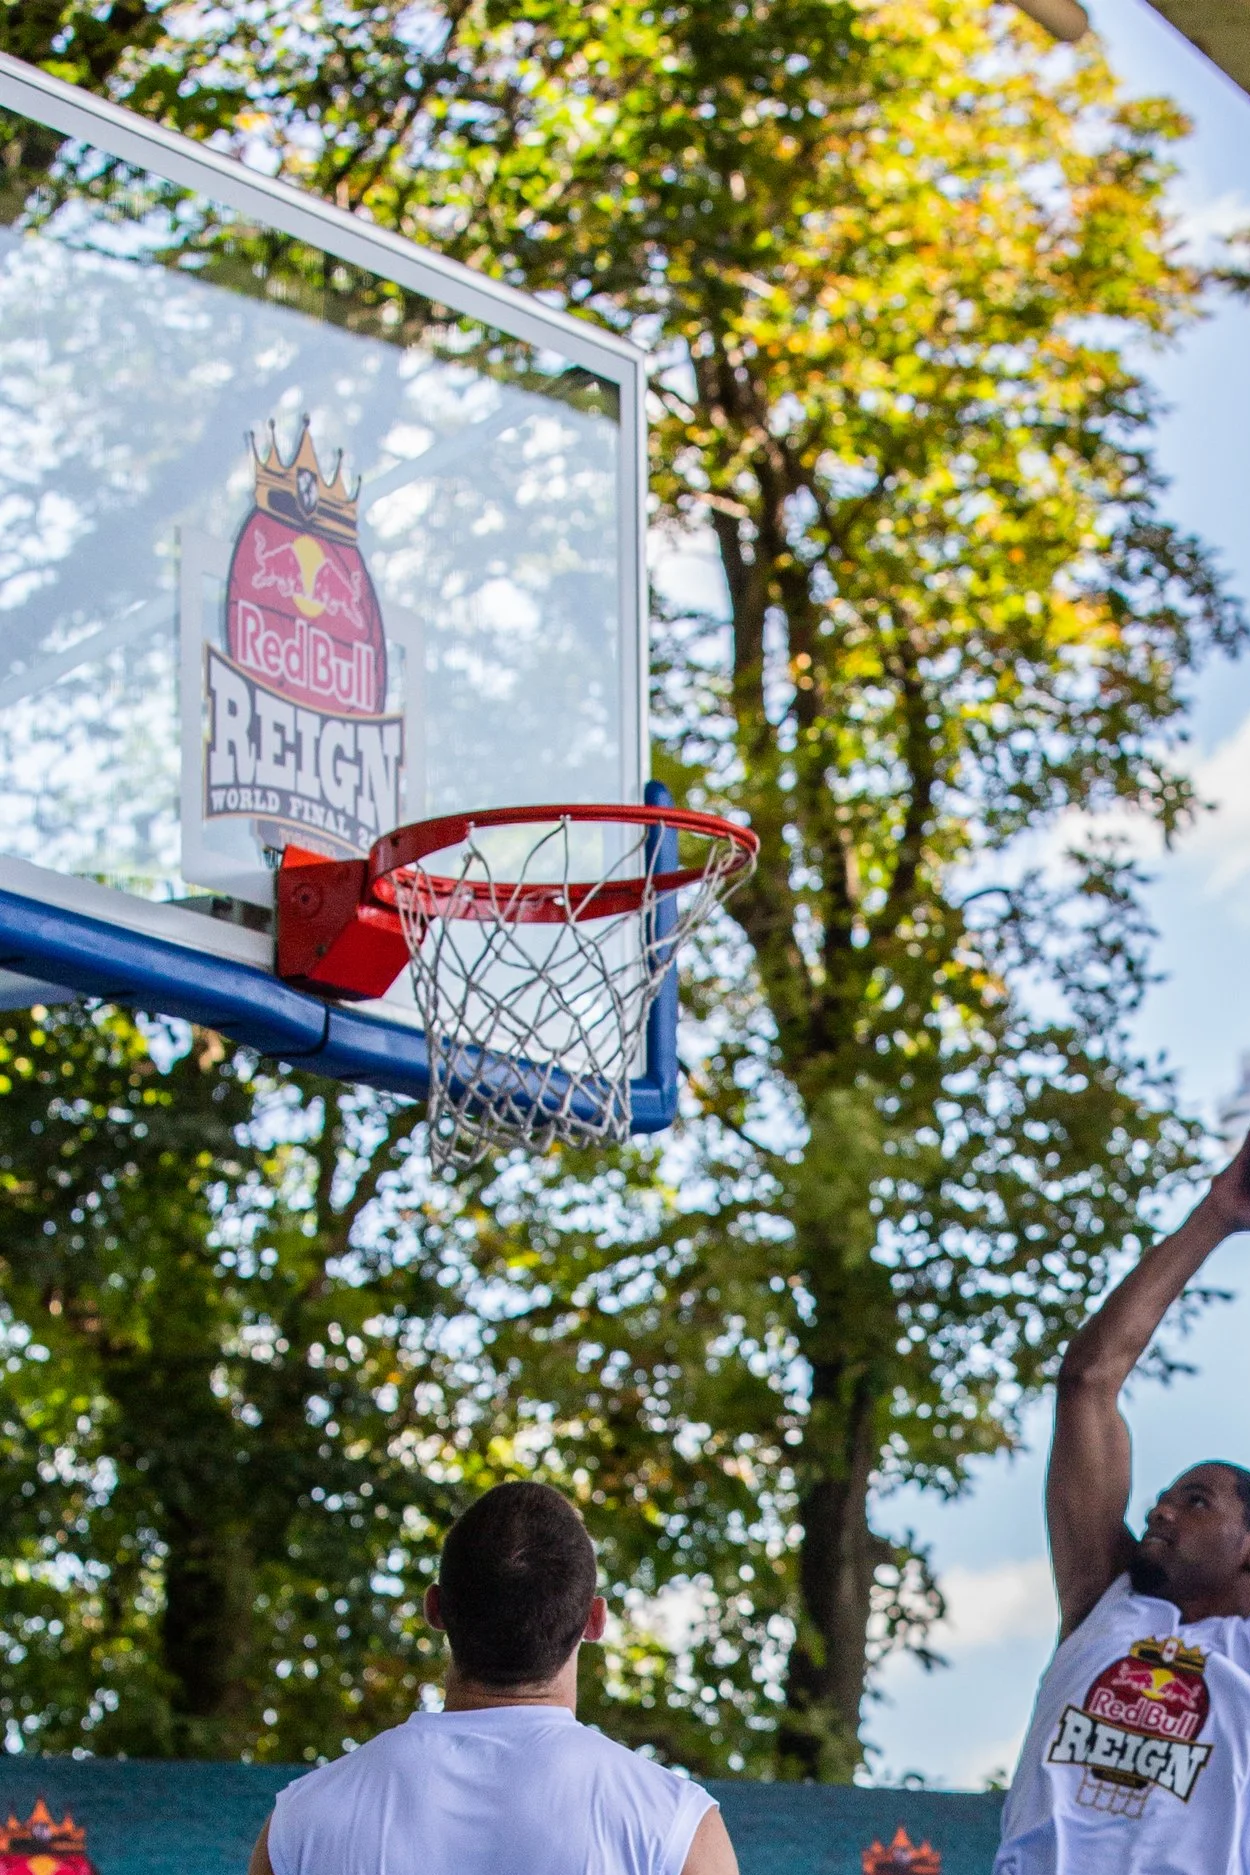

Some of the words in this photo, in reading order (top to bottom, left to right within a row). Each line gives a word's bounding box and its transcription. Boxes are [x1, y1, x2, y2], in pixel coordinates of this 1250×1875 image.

[238, 600, 308, 689] Red
[308, 626, 376, 713] Bull
[209, 655, 400, 838] REIGN
[211, 787, 281, 814] WORLD
[289, 797, 352, 842] FINAL
[1050, 1708, 1210, 1799] REIGN
[1089, 1686, 1148, 1727] Red
[1142, 1699, 1200, 1742] Bull
